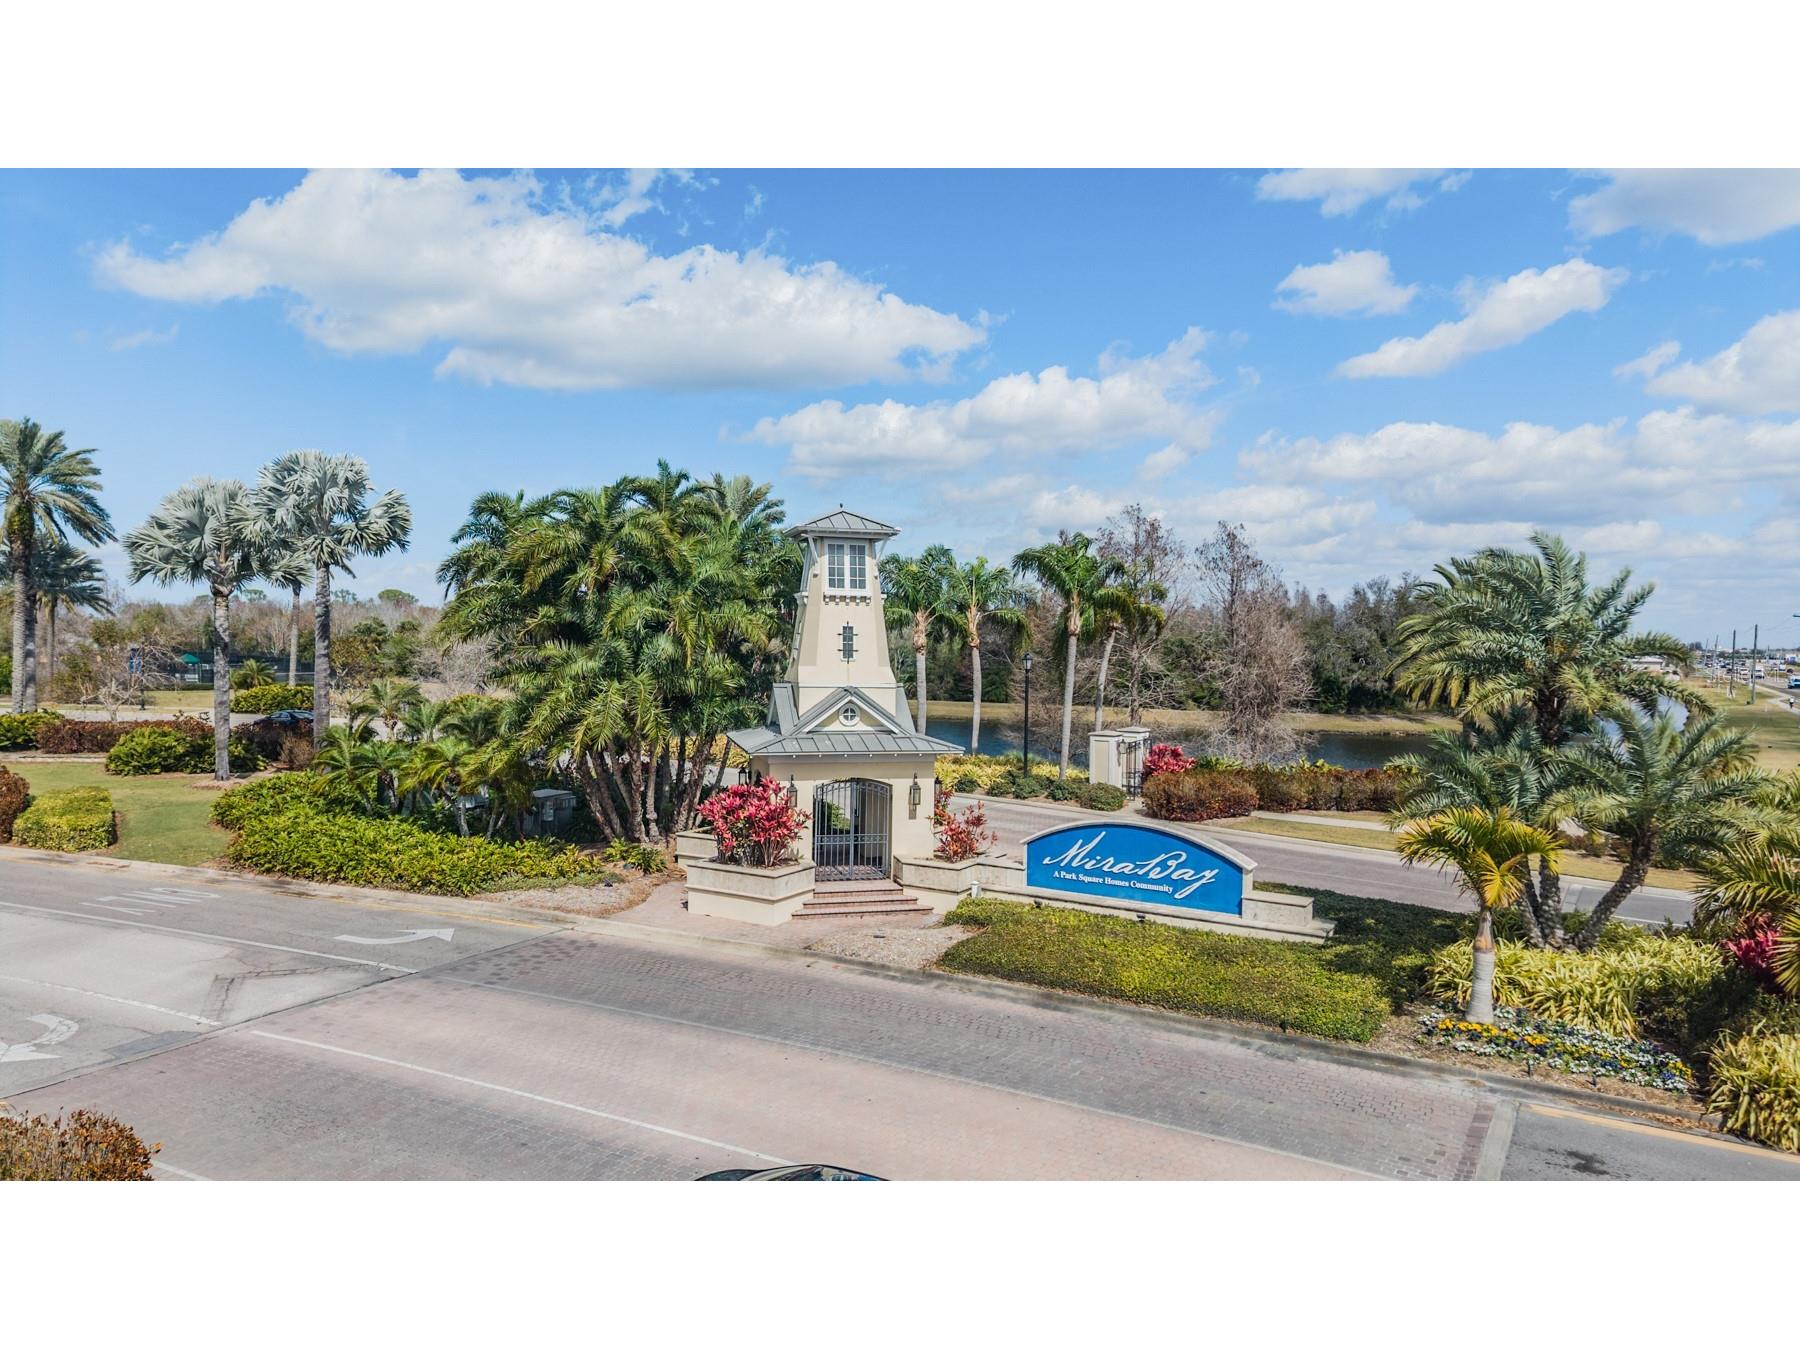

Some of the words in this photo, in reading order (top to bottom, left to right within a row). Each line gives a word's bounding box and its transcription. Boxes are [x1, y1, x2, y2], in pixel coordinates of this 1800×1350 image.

[1042, 831, 1219, 900] MiraBay
[1053, 870, 1060, 878] A
[1060, 871, 1077, 881] Park
[1078, 873, 1104, 884] Square
[1104, 876, 1130, 888] Homes
[1130, 880, 1173, 894] Community
